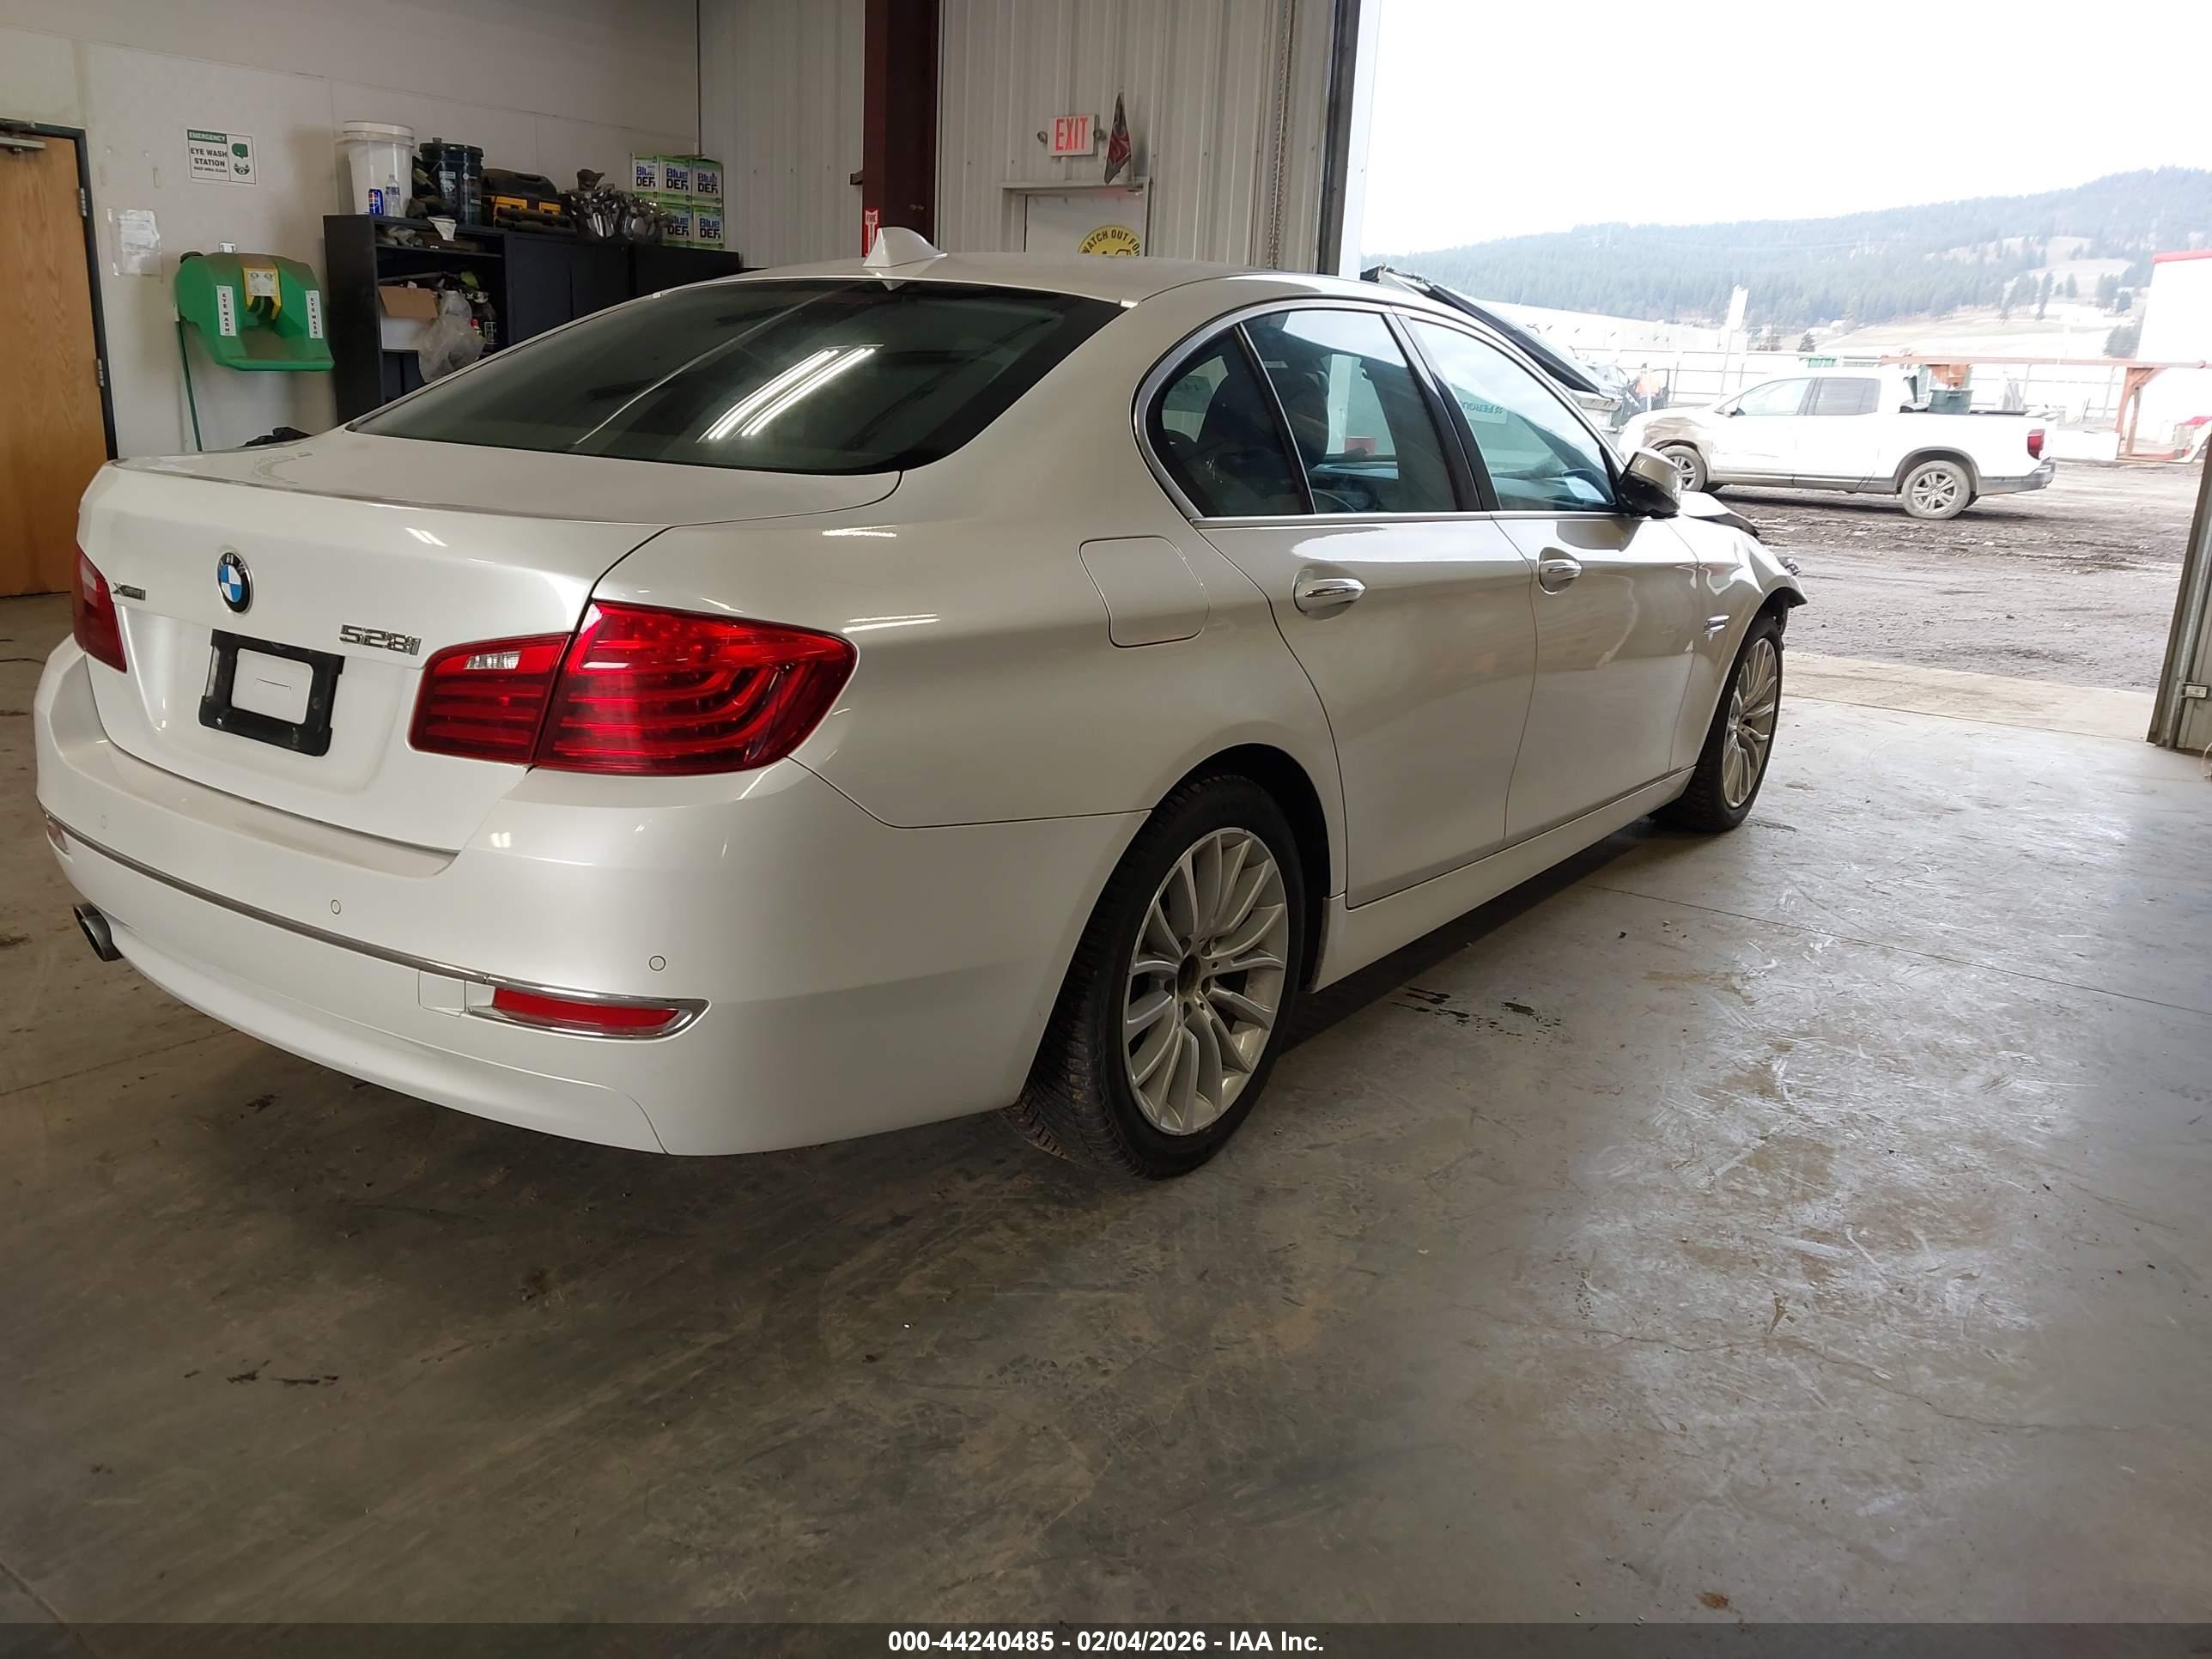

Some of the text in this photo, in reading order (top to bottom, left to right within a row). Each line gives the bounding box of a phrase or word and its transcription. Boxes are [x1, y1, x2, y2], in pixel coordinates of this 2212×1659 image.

[1055, 117, 1088, 151] EXIT
[190, 147, 228, 158] EYE WASH
[194, 158, 225, 167] STATION
[665, 167, 689, 179] Blue
[636, 177, 656, 187] DEF
[665, 178, 689, 191] DEF
[697, 182, 719, 194] DEF
[672, 216, 689, 226] lue
[699, 217, 720, 228] Blue
[667, 225, 690, 237] DEF
[699, 228, 720, 239] DEF
[1081, 229, 1109, 254] WATCH
[1111, 229, 1129, 241] OUT
